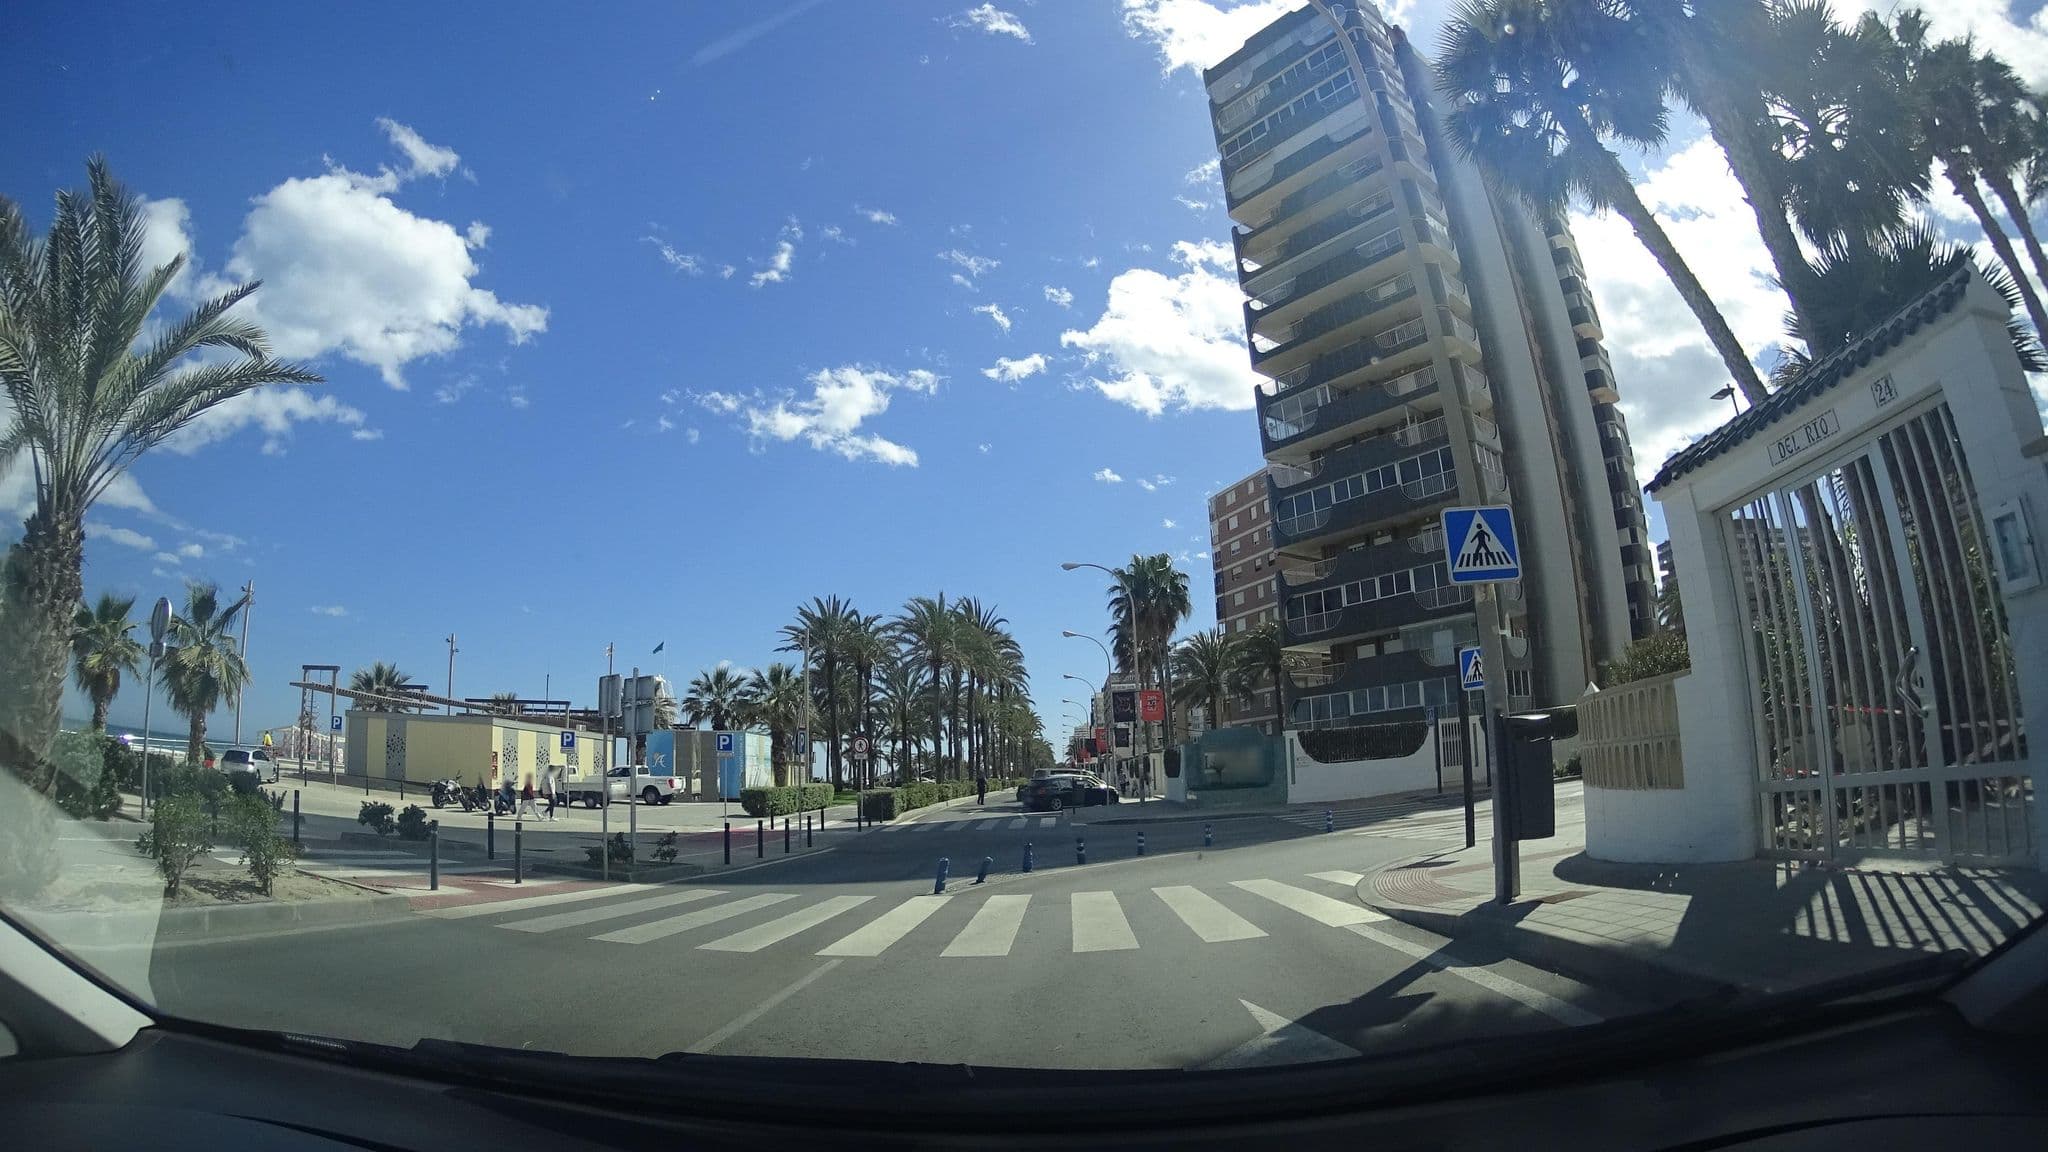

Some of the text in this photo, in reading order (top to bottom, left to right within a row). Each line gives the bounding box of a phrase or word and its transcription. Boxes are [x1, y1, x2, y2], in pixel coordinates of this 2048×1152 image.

[1875, 382, 1893, 403] 24
[1777, 417, 1829, 459] DEL RIO
[333, 717, 340, 728] P
[563, 733, 572, 746] P
[719, 735, 730, 750] P
